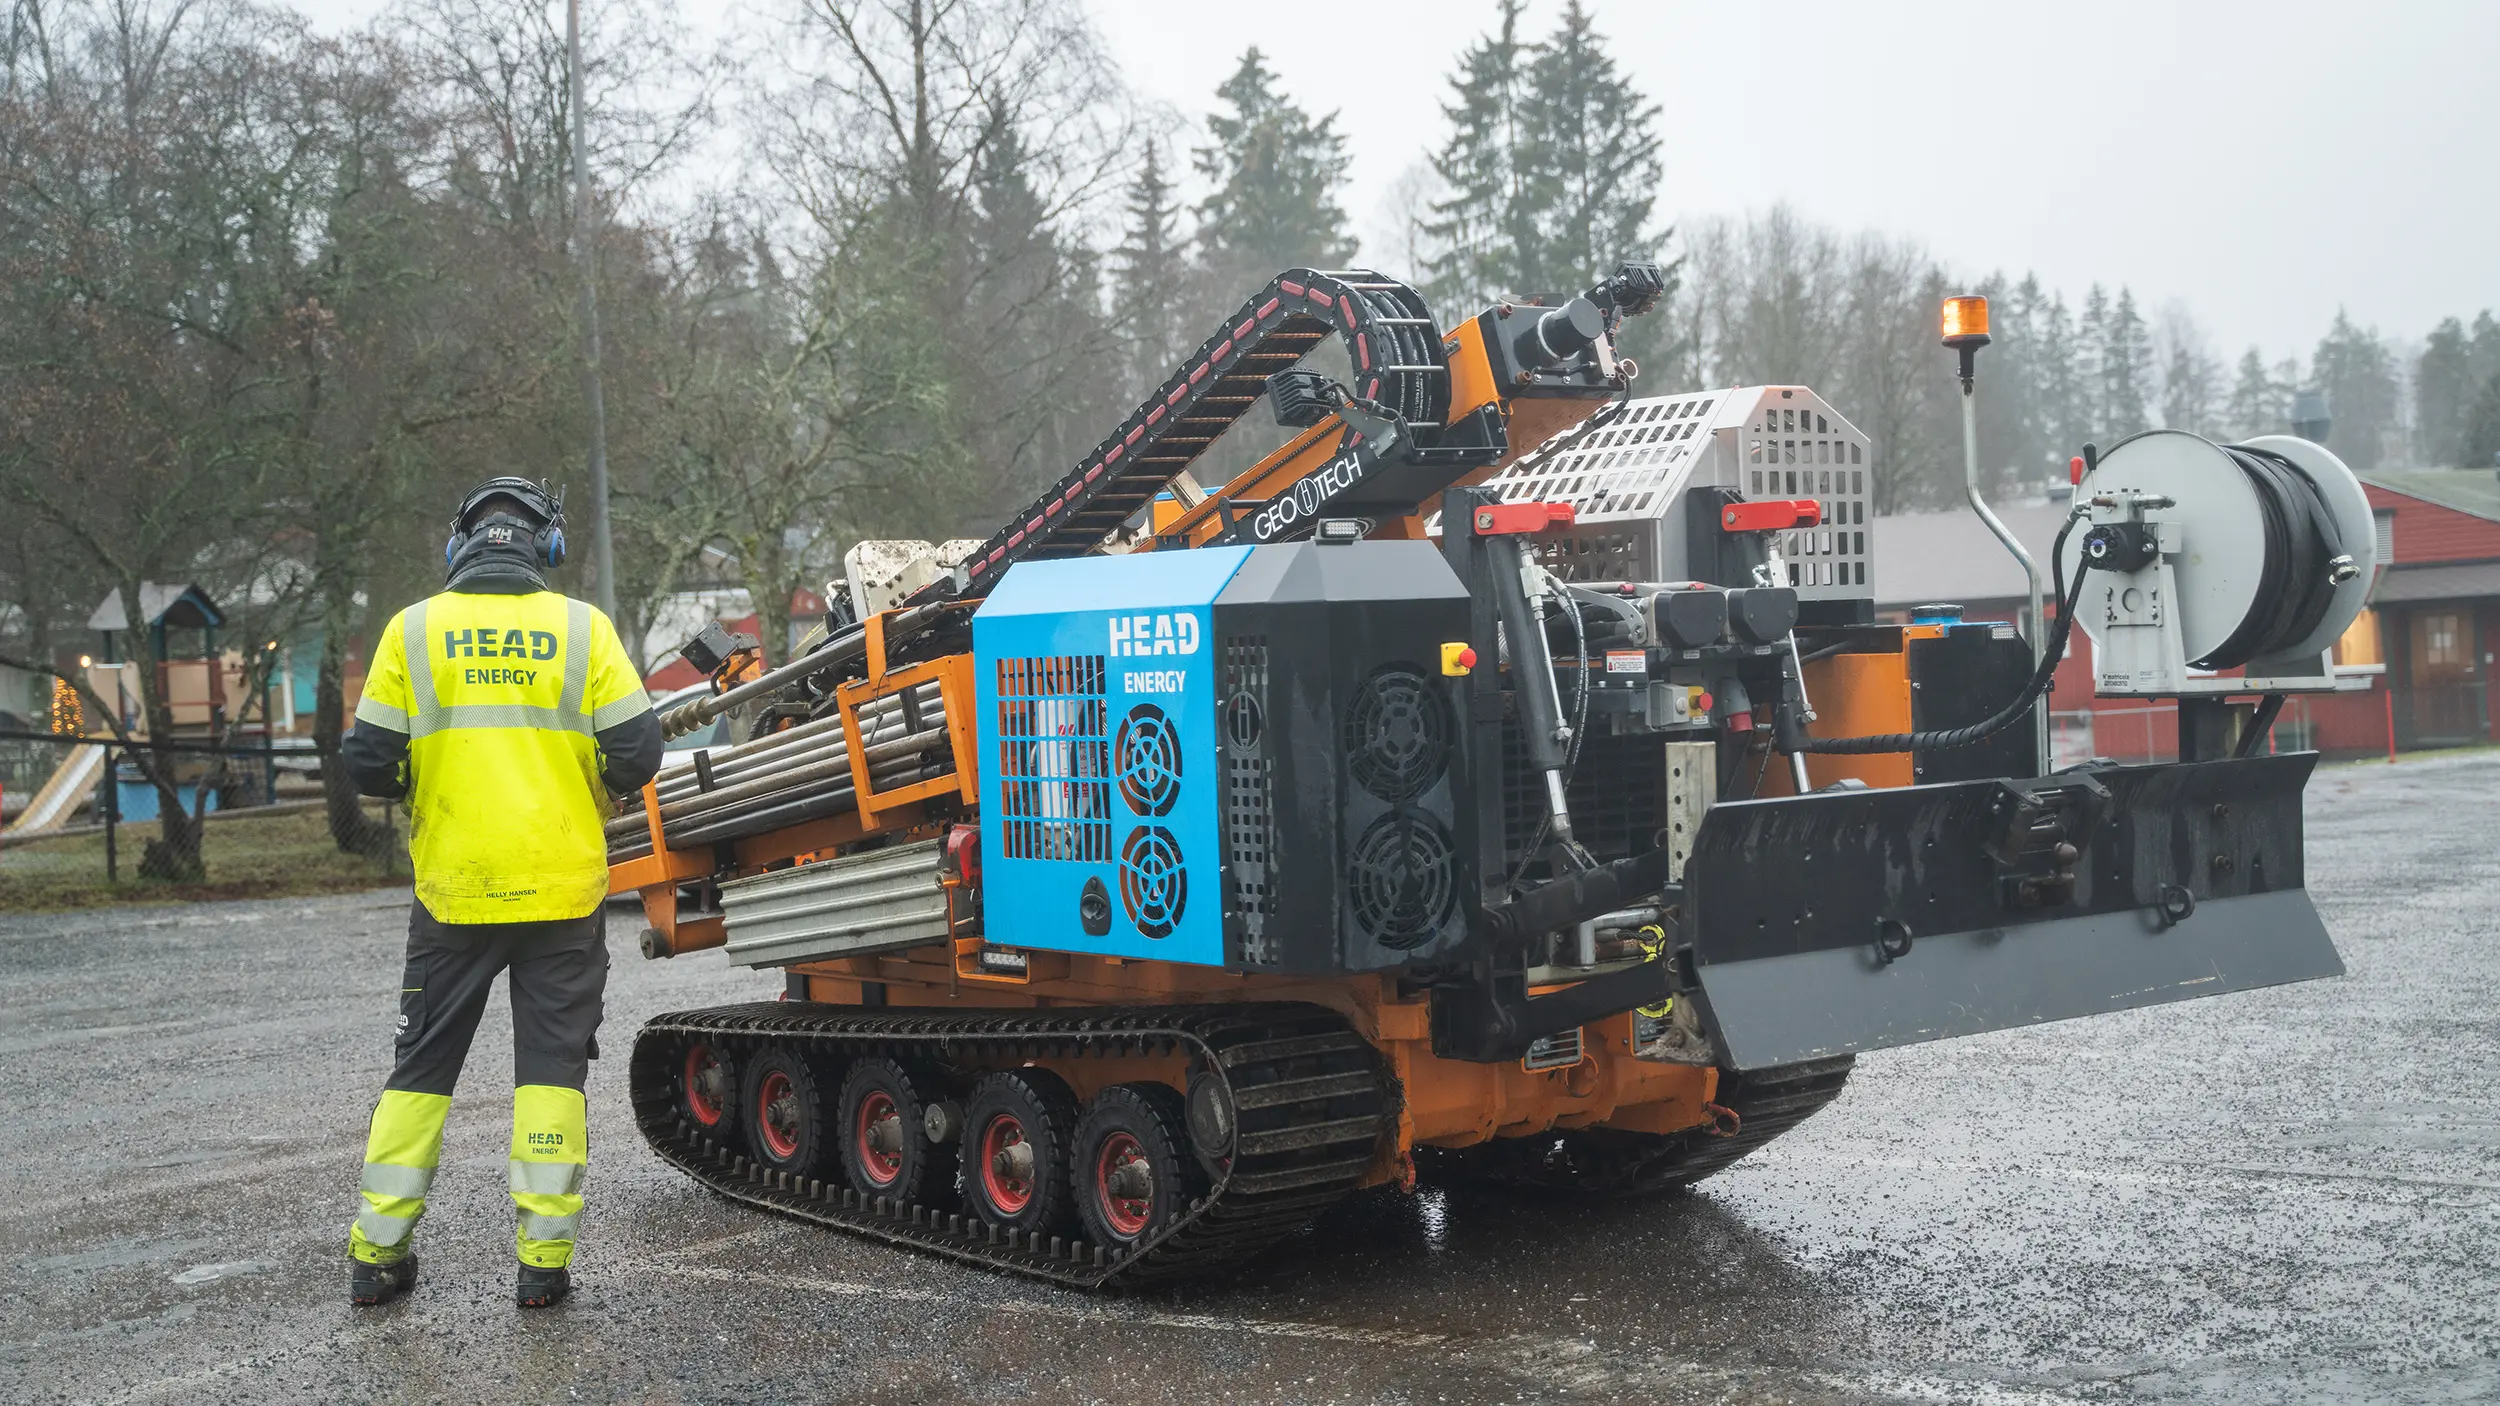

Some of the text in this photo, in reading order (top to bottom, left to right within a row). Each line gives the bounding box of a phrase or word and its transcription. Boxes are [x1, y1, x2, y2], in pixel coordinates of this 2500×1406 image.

[488, 527, 512, 540] HH
[445, 628, 557, 660] HEAD
[1109, 612, 1199, 656] HEAD
[465, 669, 537, 686] ENERGY
[1124, 670, 1186, 694] ENERGY
[528, 1132, 563, 1144] HEAD
